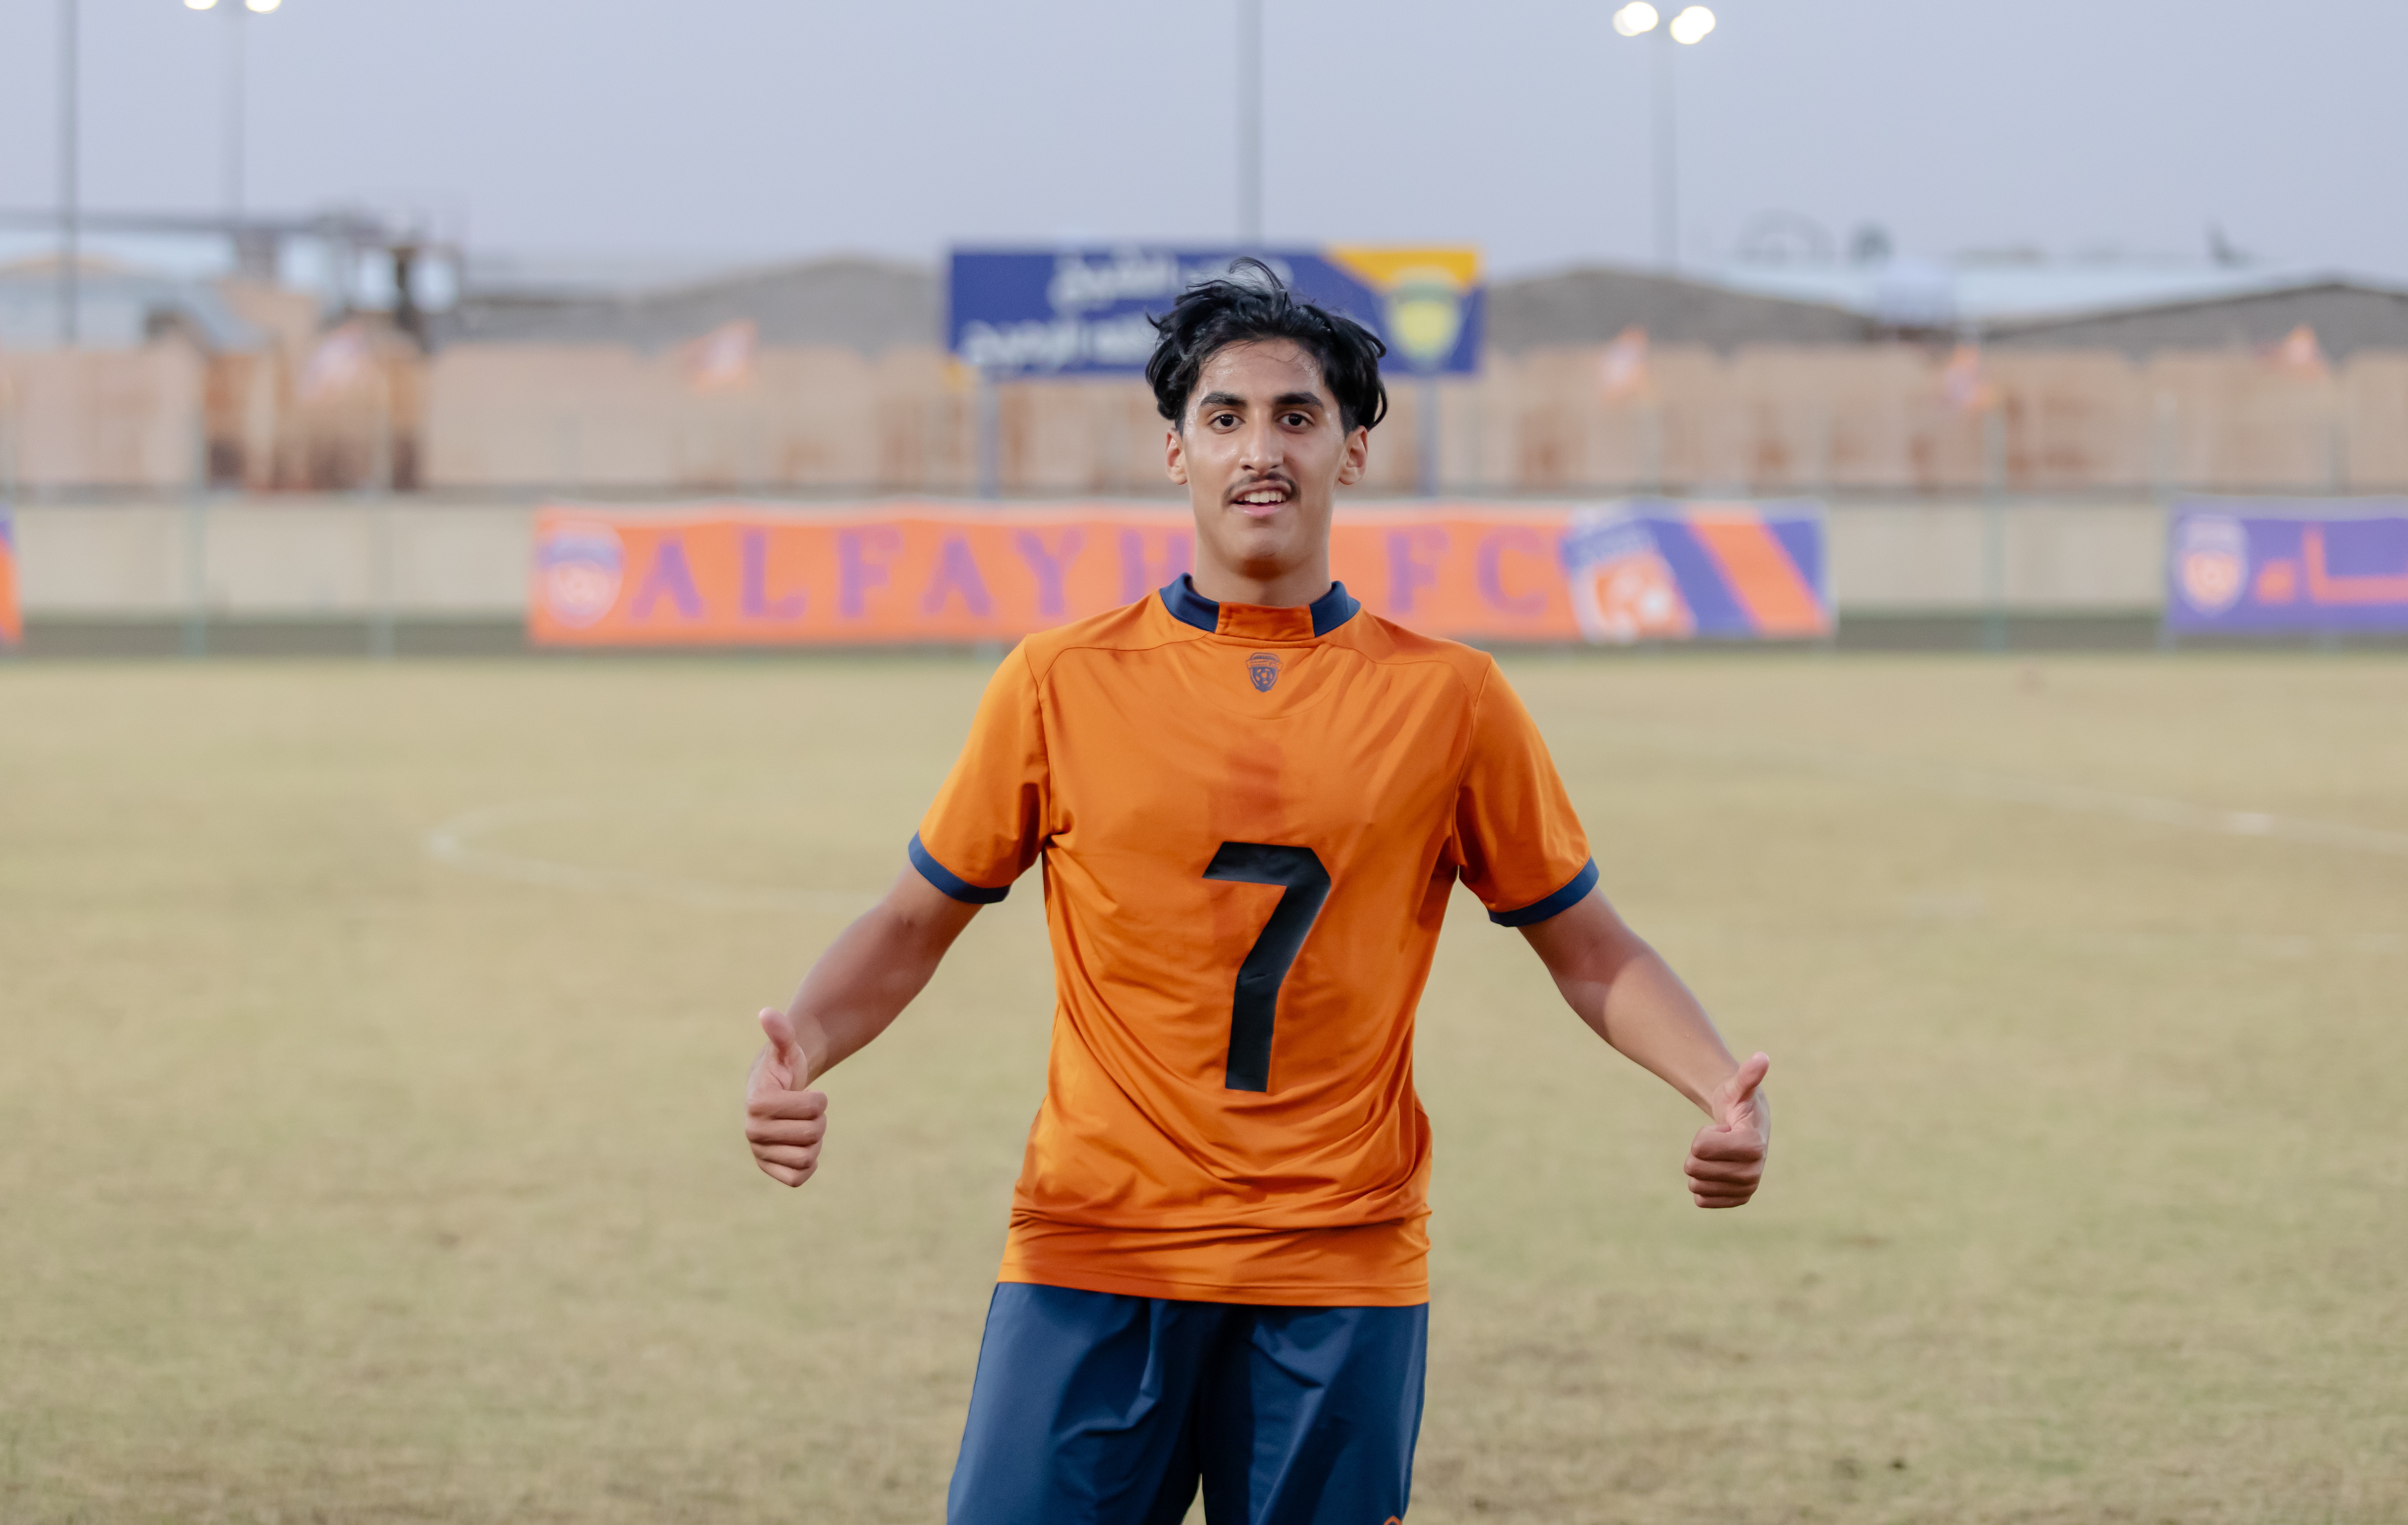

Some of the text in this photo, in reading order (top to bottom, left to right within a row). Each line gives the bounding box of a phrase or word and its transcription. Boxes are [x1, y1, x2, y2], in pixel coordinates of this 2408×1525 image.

[631, 526, 1194, 619] ALFAYH
[1386, 525, 1547, 616] FC
[1202, 841, 1332, 1093] 7
